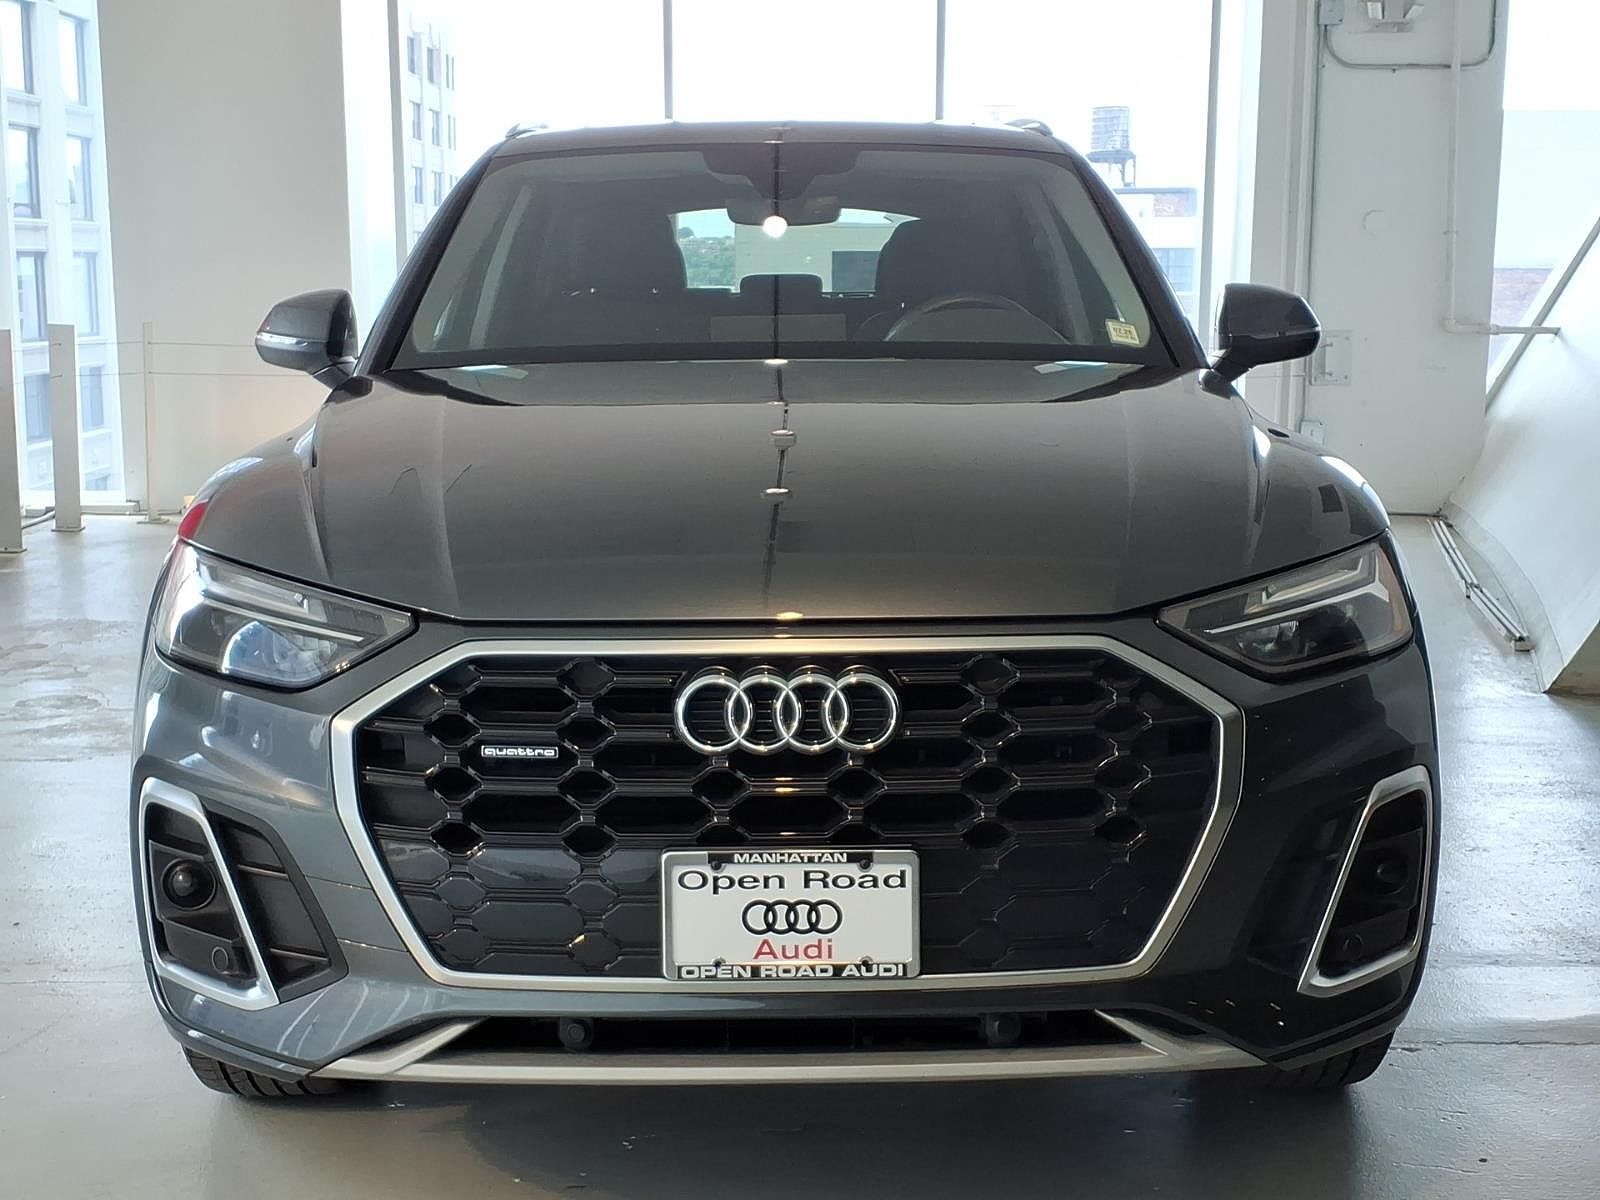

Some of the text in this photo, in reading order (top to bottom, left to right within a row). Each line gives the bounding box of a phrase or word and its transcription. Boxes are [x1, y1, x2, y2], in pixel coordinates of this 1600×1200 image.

[483, 747, 556, 757] quattro
[733, 853, 847, 863] MANHATTAN
[677, 869, 907, 894] Open Road
[753, 938, 833, 960] Audi
[681, 963, 904, 978] OPEN ROAD AUDI
